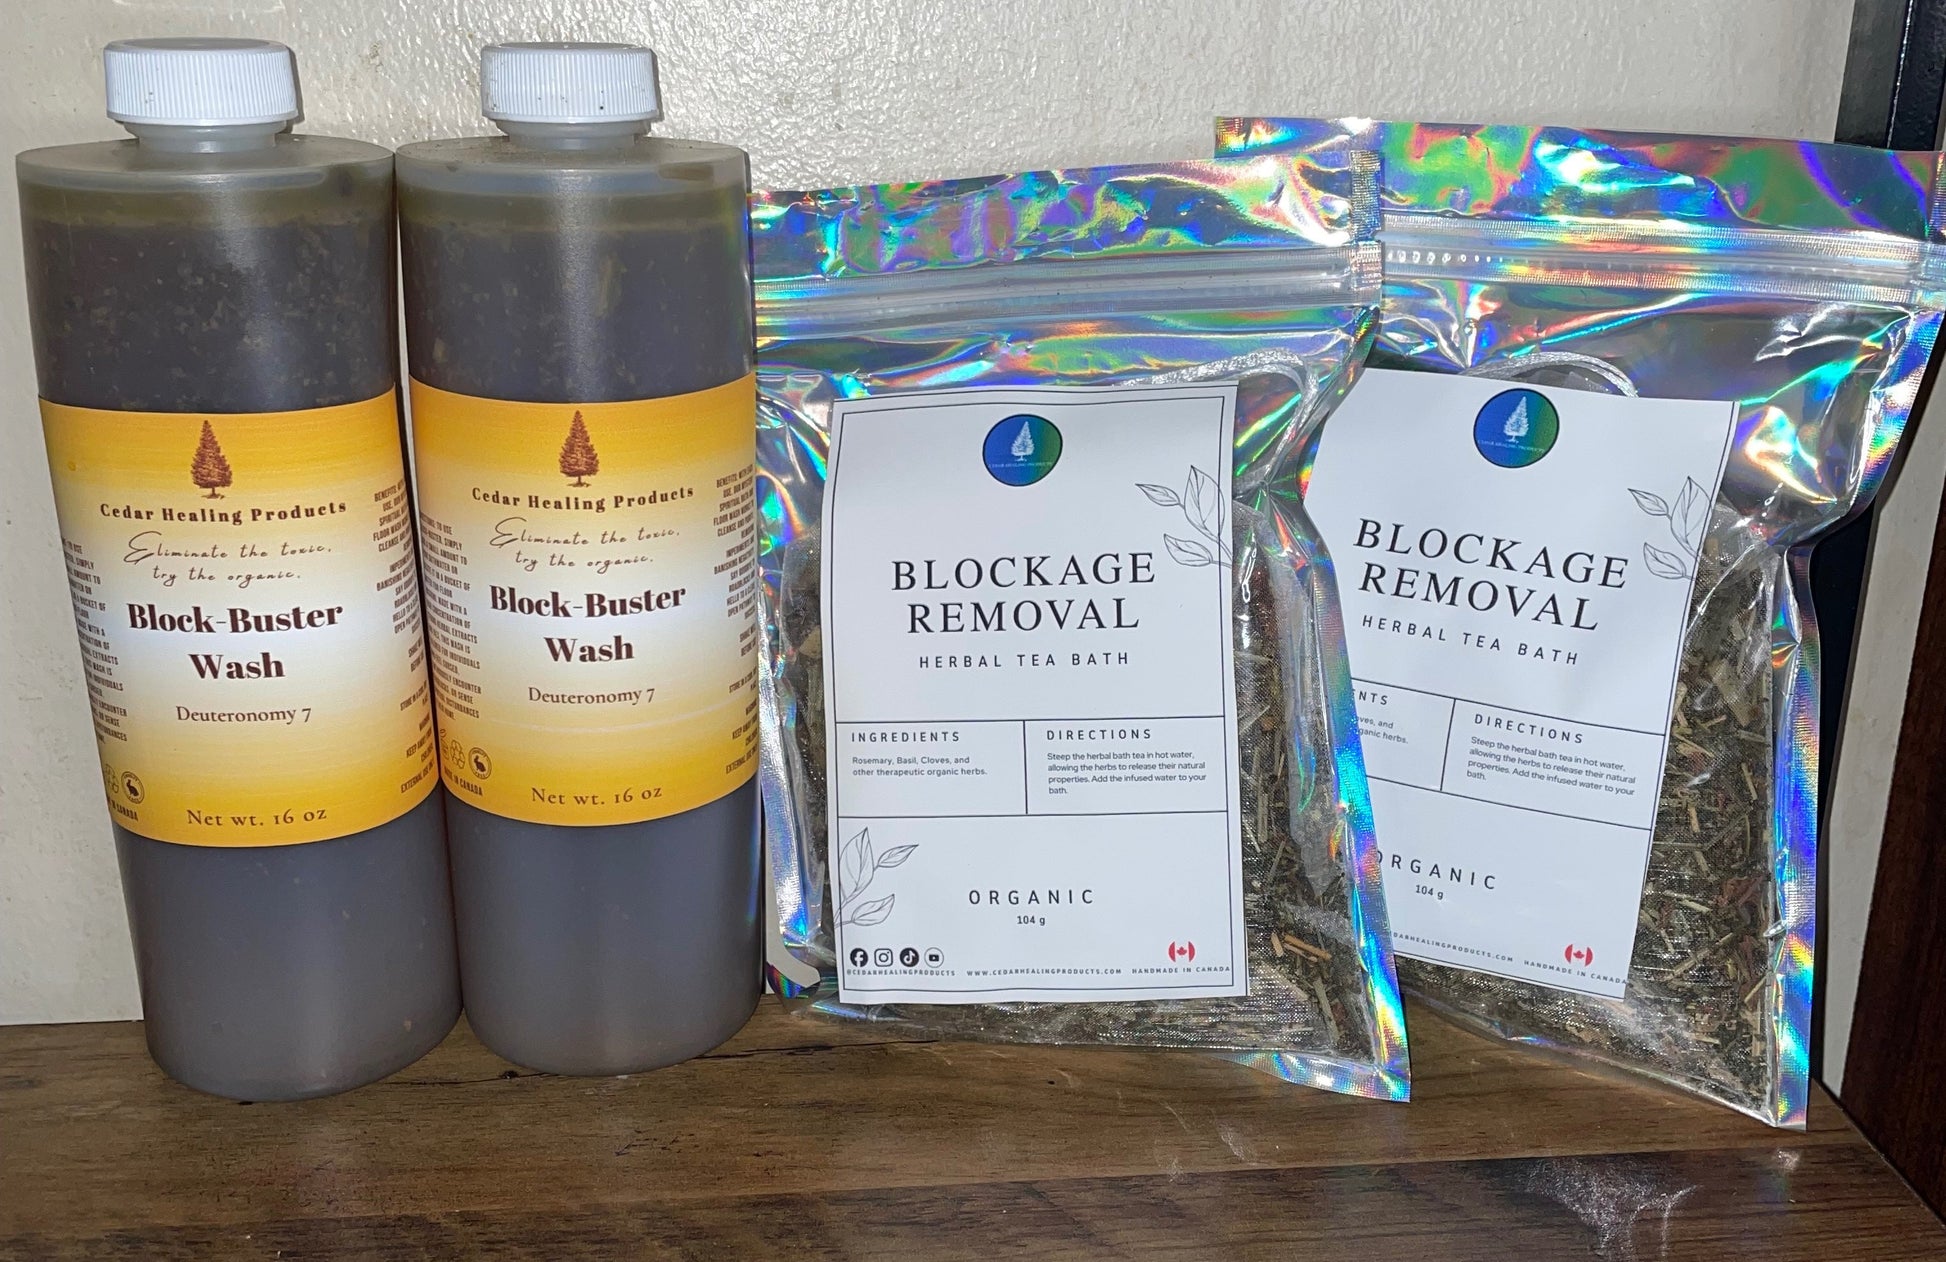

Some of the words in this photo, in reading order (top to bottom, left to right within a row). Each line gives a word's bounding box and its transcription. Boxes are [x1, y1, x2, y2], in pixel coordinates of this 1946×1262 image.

[472, 487, 521, 507] Cedar
[528, 495, 606, 513] Healing
[614, 486, 694, 508] Products
[100, 504, 154, 520] Cedar
[162, 508, 243, 526] Healing
[251, 501, 347, 522] Products
[489, 517, 589, 548] Eliminate
[600, 531, 627, 545] the
[123, 531, 228, 565] Eliminate
[240, 544, 268, 558] the
[1353, 518, 1629, 589] BLOCKAGE
[515, 550, 539, 572] try
[549, 553, 576, 567] the
[587, 556, 654, 574] organic.
[891, 552, 1156, 591] BLOCKAGE
[153, 565, 177, 587] try
[188, 567, 216, 581] the
[227, 571, 301, 589] organic.
[489, 584, 686, 618] Block-Buster
[1358, 562, 1599, 631] REMOVAL
[126, 603, 344, 634] Block-Buster
[907, 597, 1140, 634] REMOVAL
[544, 635, 635, 663] Wash
[1362, 614, 1447, 642] HERBAL
[1463, 632, 1501, 651] TEA
[1517, 643, 1579, 666] BATH
[188, 652, 286, 679] Wash
[919, 654, 1002, 669] HERBAL
[1017, 653, 1056, 667] TEA
[1071, 652, 1129, 666] BATH
[528, 686, 642, 706] Deuteronomy
[646, 688, 656, 703] 7
[175, 705, 297, 725] Deuteronomy
[301, 707, 312, 723] 7
[1378, 720, 1394, 729] and
[851, 732, 960, 743] INGREDIENTS
[1046, 729, 1151, 741] DIRECTIONS
[1383, 731, 1409, 744] herbs.
[1475, 713, 1584, 744] DIRECTIONS
[852, 757, 895, 766] Rosemary,
[896, 756, 919, 766] Basil,
[920, 756, 952, 766] Cloves,
[954, 756, 970, 765] and
[1047, 752, 1071, 762] Steep
[1072, 752, 1086, 761] the
[1086, 752, 1112, 761] herbal
[1113, 752, 1131, 760] bath
[1147, 751, 1154, 759] in
[1155, 751, 1169, 759] hot
[1170, 752, 1195, 760] water,
[1471, 736, 1496, 749] Steep
[1496, 742, 1511, 751] the
[1511, 744, 1537, 756] herbal
[1538, 750, 1557, 760] bath
[1559, 753, 1573, 763] tea
[1574, 755, 1582, 764] in
[1583, 757, 1598, 767] hot
[852, 768, 874, 776] other
[876, 768, 925, 777] therapeutic
[927, 768, 959, 777] organic
[961, 767, 988, 776] herbs.
[1047, 764, 1079, 773] allowing
[1080, 764, 1094, 772] the
[1094, 763, 1117, 771] herbs
[1118, 763, 1127, 771] to
[1128, 763, 1157, 771] release
[1158, 762, 1176, 770] their
[1177, 762, 1206, 770] natural
[1466, 769, 1487, 781] bath.
[1469, 748, 1501, 762] allowing
[1503, 754, 1517, 764] the
[1517, 756, 1541, 769] herbs
[1542, 761, 1552, 770] to
[1552, 763, 1583, 776] release
[1585, 769, 1604, 779] their
[1606, 772, 1636, 784] natural
[1048, 775, 1090, 785] properties.
[1091, 775, 1108, 783] Add
[1124, 774, 1153, 782] infused
[1154, 774, 1177, 782] water
[1188, 774, 1207, 783] your
[1467, 759, 1510, 774] properties.
[1512, 768, 1530, 778] Add
[1531, 772, 1546, 781] the
[1546, 775, 1578, 787] infused
[1579, 780, 1603, 790] water
[1604, 784, 1614, 793] to
[1615, 787, 1636, 796] your
[531, 787, 566, 805] Net
[573, 795, 605, 805] wt.
[614, 787, 633, 804] 16
[641, 787, 662, 800] oz
[1048, 787, 1068, 795] bath.
[186, 809, 223, 826] Net
[231, 815, 264, 826] wt.
[273, 808, 294, 825] 16
[303, 809, 327, 821] oz
[968, 889, 1093, 905] ORGANIC
[1415, 884, 1434, 896] 104
[1437, 891, 1444, 901] g
[1016, 915, 1036, 925] 104
[1039, 917, 1046, 926] g
[1392, 931, 1513, 962] DARHEALINGPRODUCTS.COM
[1524, 960, 1573, 975] HANDMADE
[1591, 973, 1628, 985] CANADA
[967, 968, 1122, 977] WWW.CEDARHEALINGPRODUCTS.COM
[1131, 967, 1179, 975] HANDMADE
[1183, 966, 1192, 974] IN
